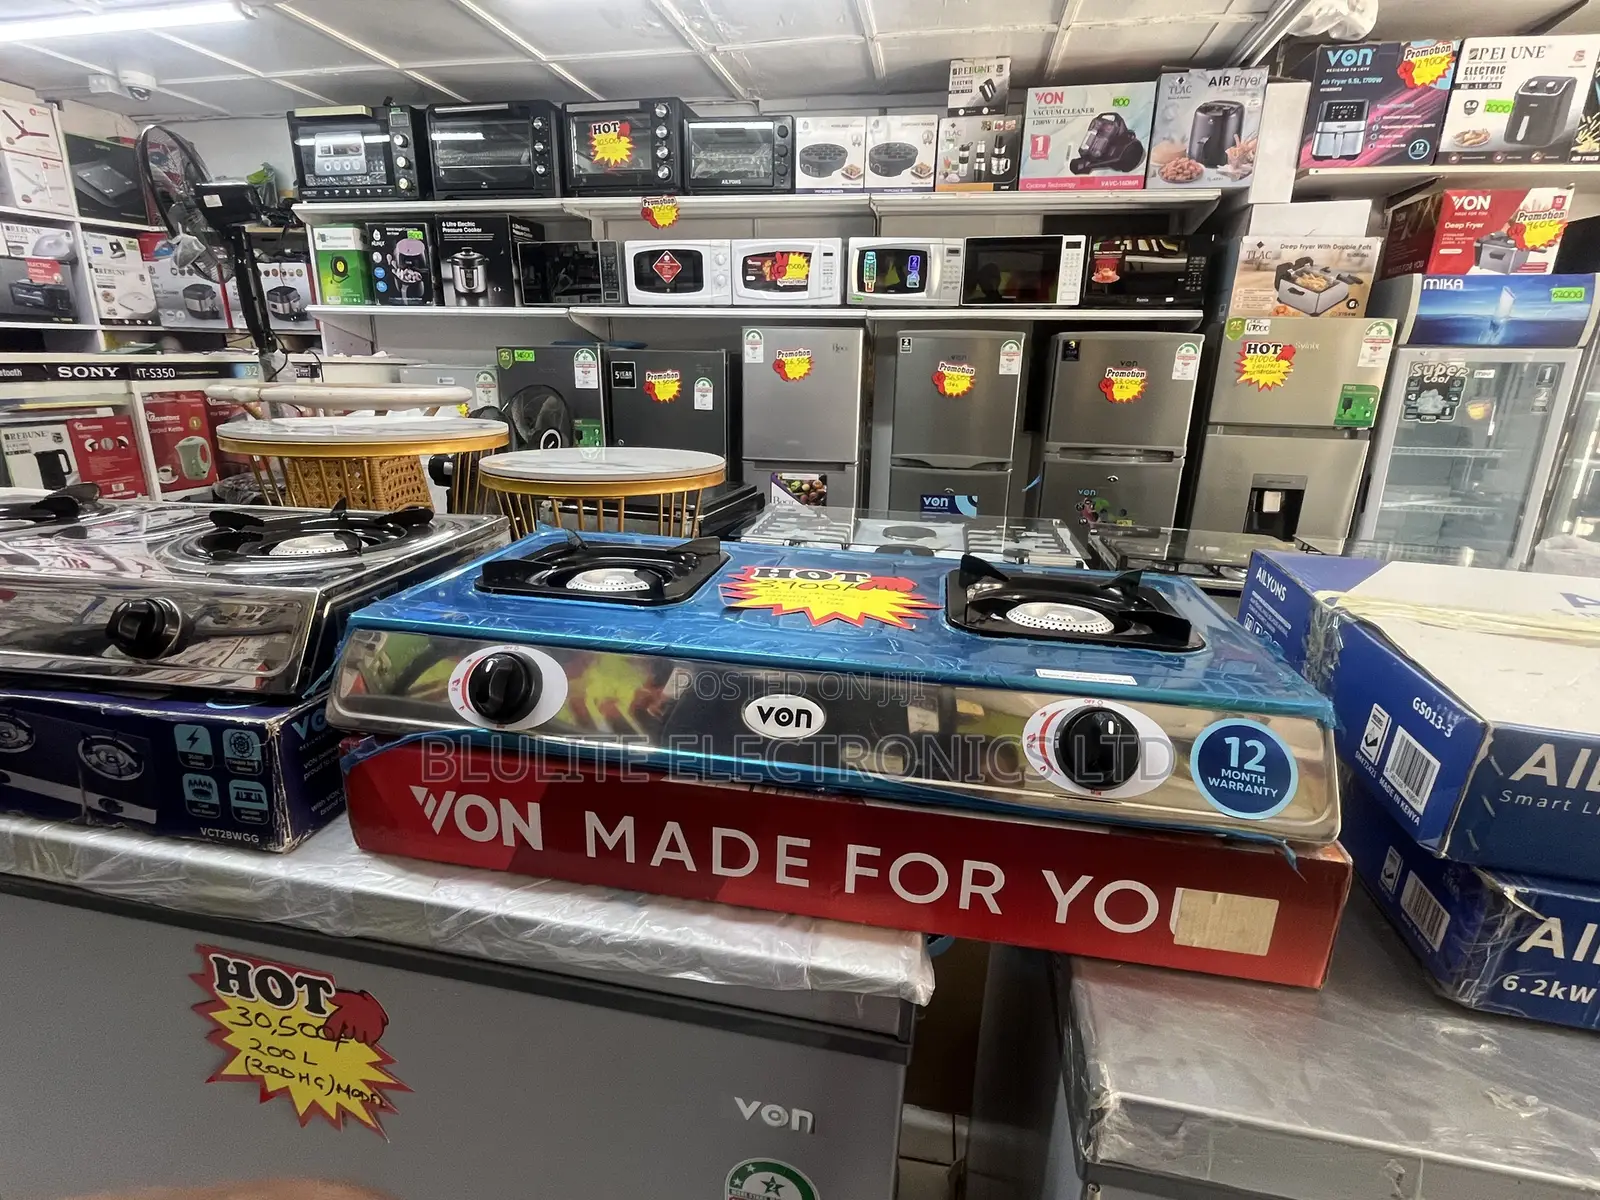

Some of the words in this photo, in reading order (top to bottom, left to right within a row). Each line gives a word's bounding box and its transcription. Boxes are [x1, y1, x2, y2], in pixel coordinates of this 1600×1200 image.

[1327, 48, 1374, 66] von
[1405, 44, 1451, 60] Promotion
[1464, 65, 1506, 76] ELECTRIC
[1208, 76, 1231, 87] AIR
[1234, 75, 1262, 88] Fryer
[1168, 85, 1192, 95] TLAC
[1035, 91, 1064, 105] VON
[592, 122, 619, 135] HOT
[1035, 136, 1045, 152] 1
[1415, 143, 1424, 151] 12
[1452, 195, 1491, 210] VON
[1518, 210, 1565, 222] Promotion
[1445, 222, 1464, 230] Deep
[1466, 221, 1485, 229] Fryer
[1247, 251, 1272, 260] TLAC
[1231, 321, 1242, 331] 25
[777, 349, 811, 358] Promotion
[1246, 343, 1282, 355] HOT
[57, 366, 120, 379] SONY
[614, 371, 620, 379] 5
[940, 362, 975, 374] Promotion
[1106, 368, 1146, 378] Promotion
[1412, 362, 1468, 378] Super
[646, 373, 679, 381] Promotion
[1423, 375, 1451, 384] Cool
[1078, 488, 1097, 496] von
[923, 496, 949, 508] von
[755, 567, 867, 583] HOT
[1255, 566, 1287, 602] AILYONS
[756, 704, 813, 729] von
[1412, 696, 1454, 738] GS013-3
[1223, 736, 1267, 773] 12
[1221, 768, 1267, 785] MONTH
[1207, 776, 1279, 798] WARRANTY
[1378, 776, 1395, 798] MADE
[1399, 801, 1421, 826] KENYA
[1498, 789, 1572, 812] Smart
[200, 826, 260, 843] VCT2BWGG
[409, 785, 544, 851] VON
[584, 810, 811, 888] MADE
[844, 843, 1005, 915] FOR
[1041, 868, 1184, 937] YO
[211, 955, 335, 1017] HOT
[1501, 974, 1599, 1005] 6.2kW
[249, 1037, 297, 1060] 200
[303, 1051, 318, 1066] L
[733, 1096, 815, 1135] von
